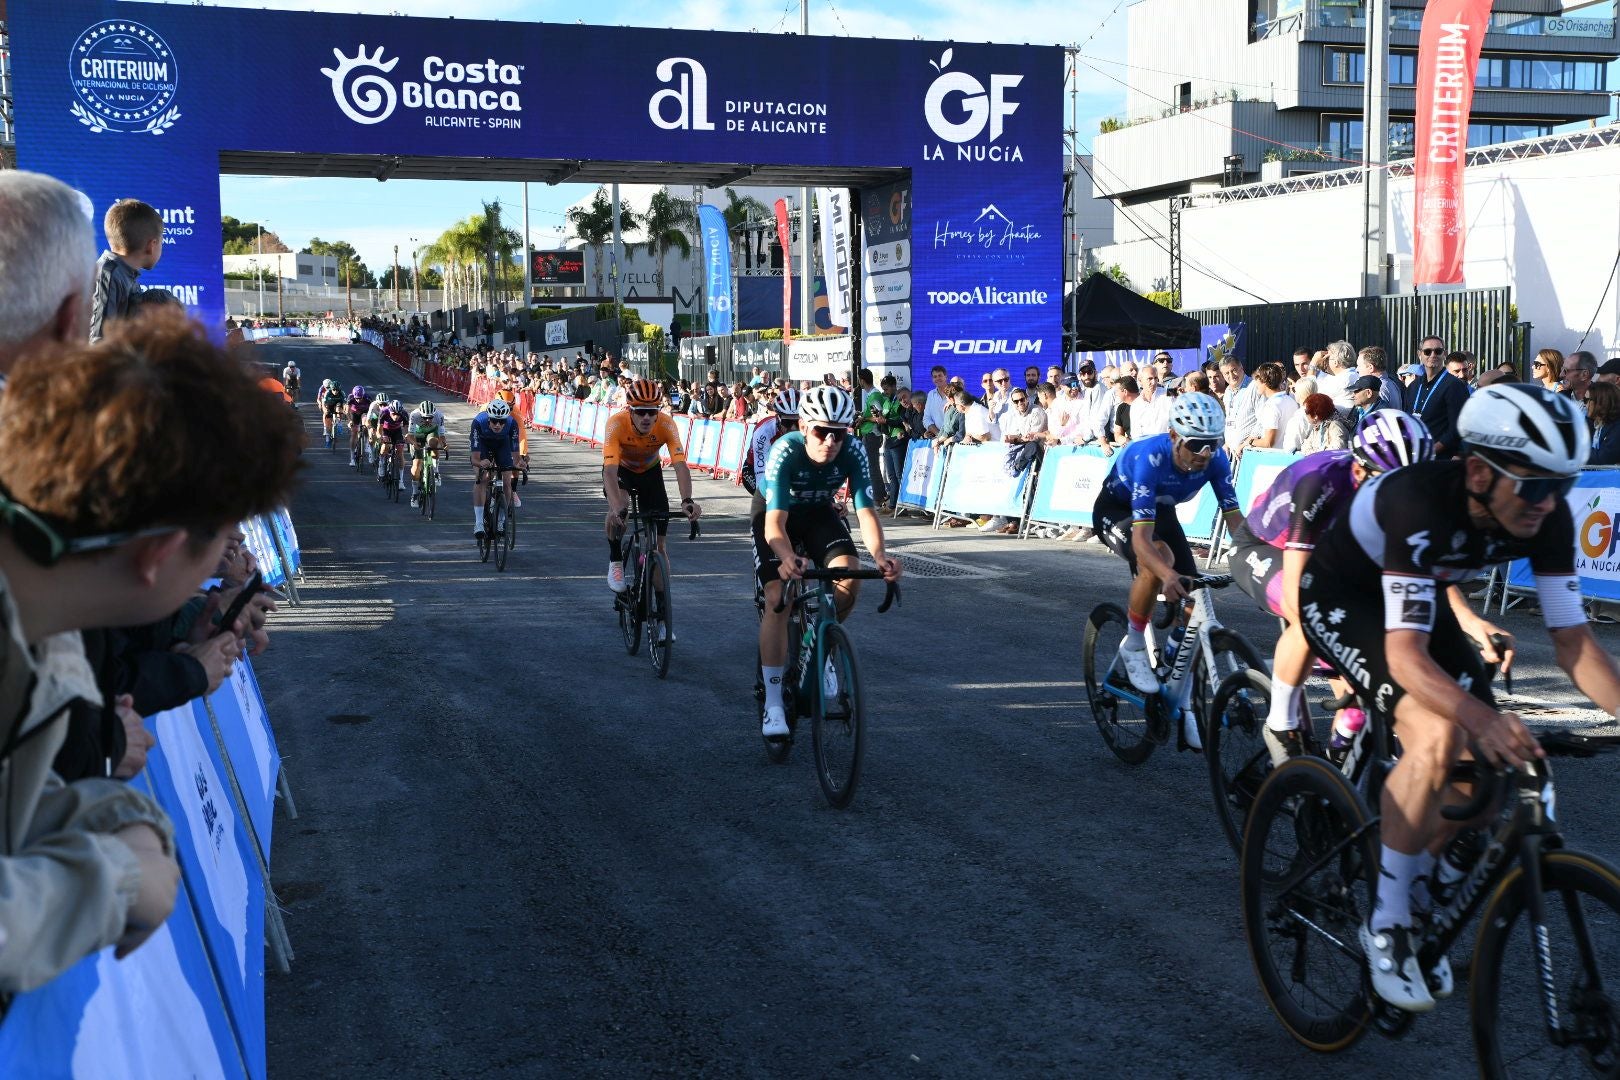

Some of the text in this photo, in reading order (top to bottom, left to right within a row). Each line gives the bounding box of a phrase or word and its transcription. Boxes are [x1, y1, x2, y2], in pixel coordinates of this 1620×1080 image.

[1548, 20, 1565, 31] OS
[81, 58, 168, 82] CRITERIUM
[423, 56, 521, 84] Costa
[75, 80, 130, 90] INTERNACIONAL
[142, 82, 174, 91] CICLISMO
[1429, 23, 1470, 164] CRITERIUM
[402, 86, 522, 112] Blanca
[924, 71, 1024, 143] GF
[725, 100, 826, 116] DIPUTACION
[425, 115, 521, 128] ALICANTE SPAIN
[726, 119, 826, 134] DE ALICANTE
[924, 144, 944, 160] LA
[1424, 198, 1458, 208] CRITERIUM
[157, 206, 194, 224] unt
[162, 227, 192, 235] EVISIÓ
[934, 221, 975, 250] Homes
[978, 226, 996, 248] by
[927, 286, 1048, 304] TODOAlicante
[932, 339, 1042, 354] PODIUM
[1576, 558, 1586, 568] LA
[1172, 626, 1198, 681] CANYON
[1302, 602, 1371, 690] Medellín
